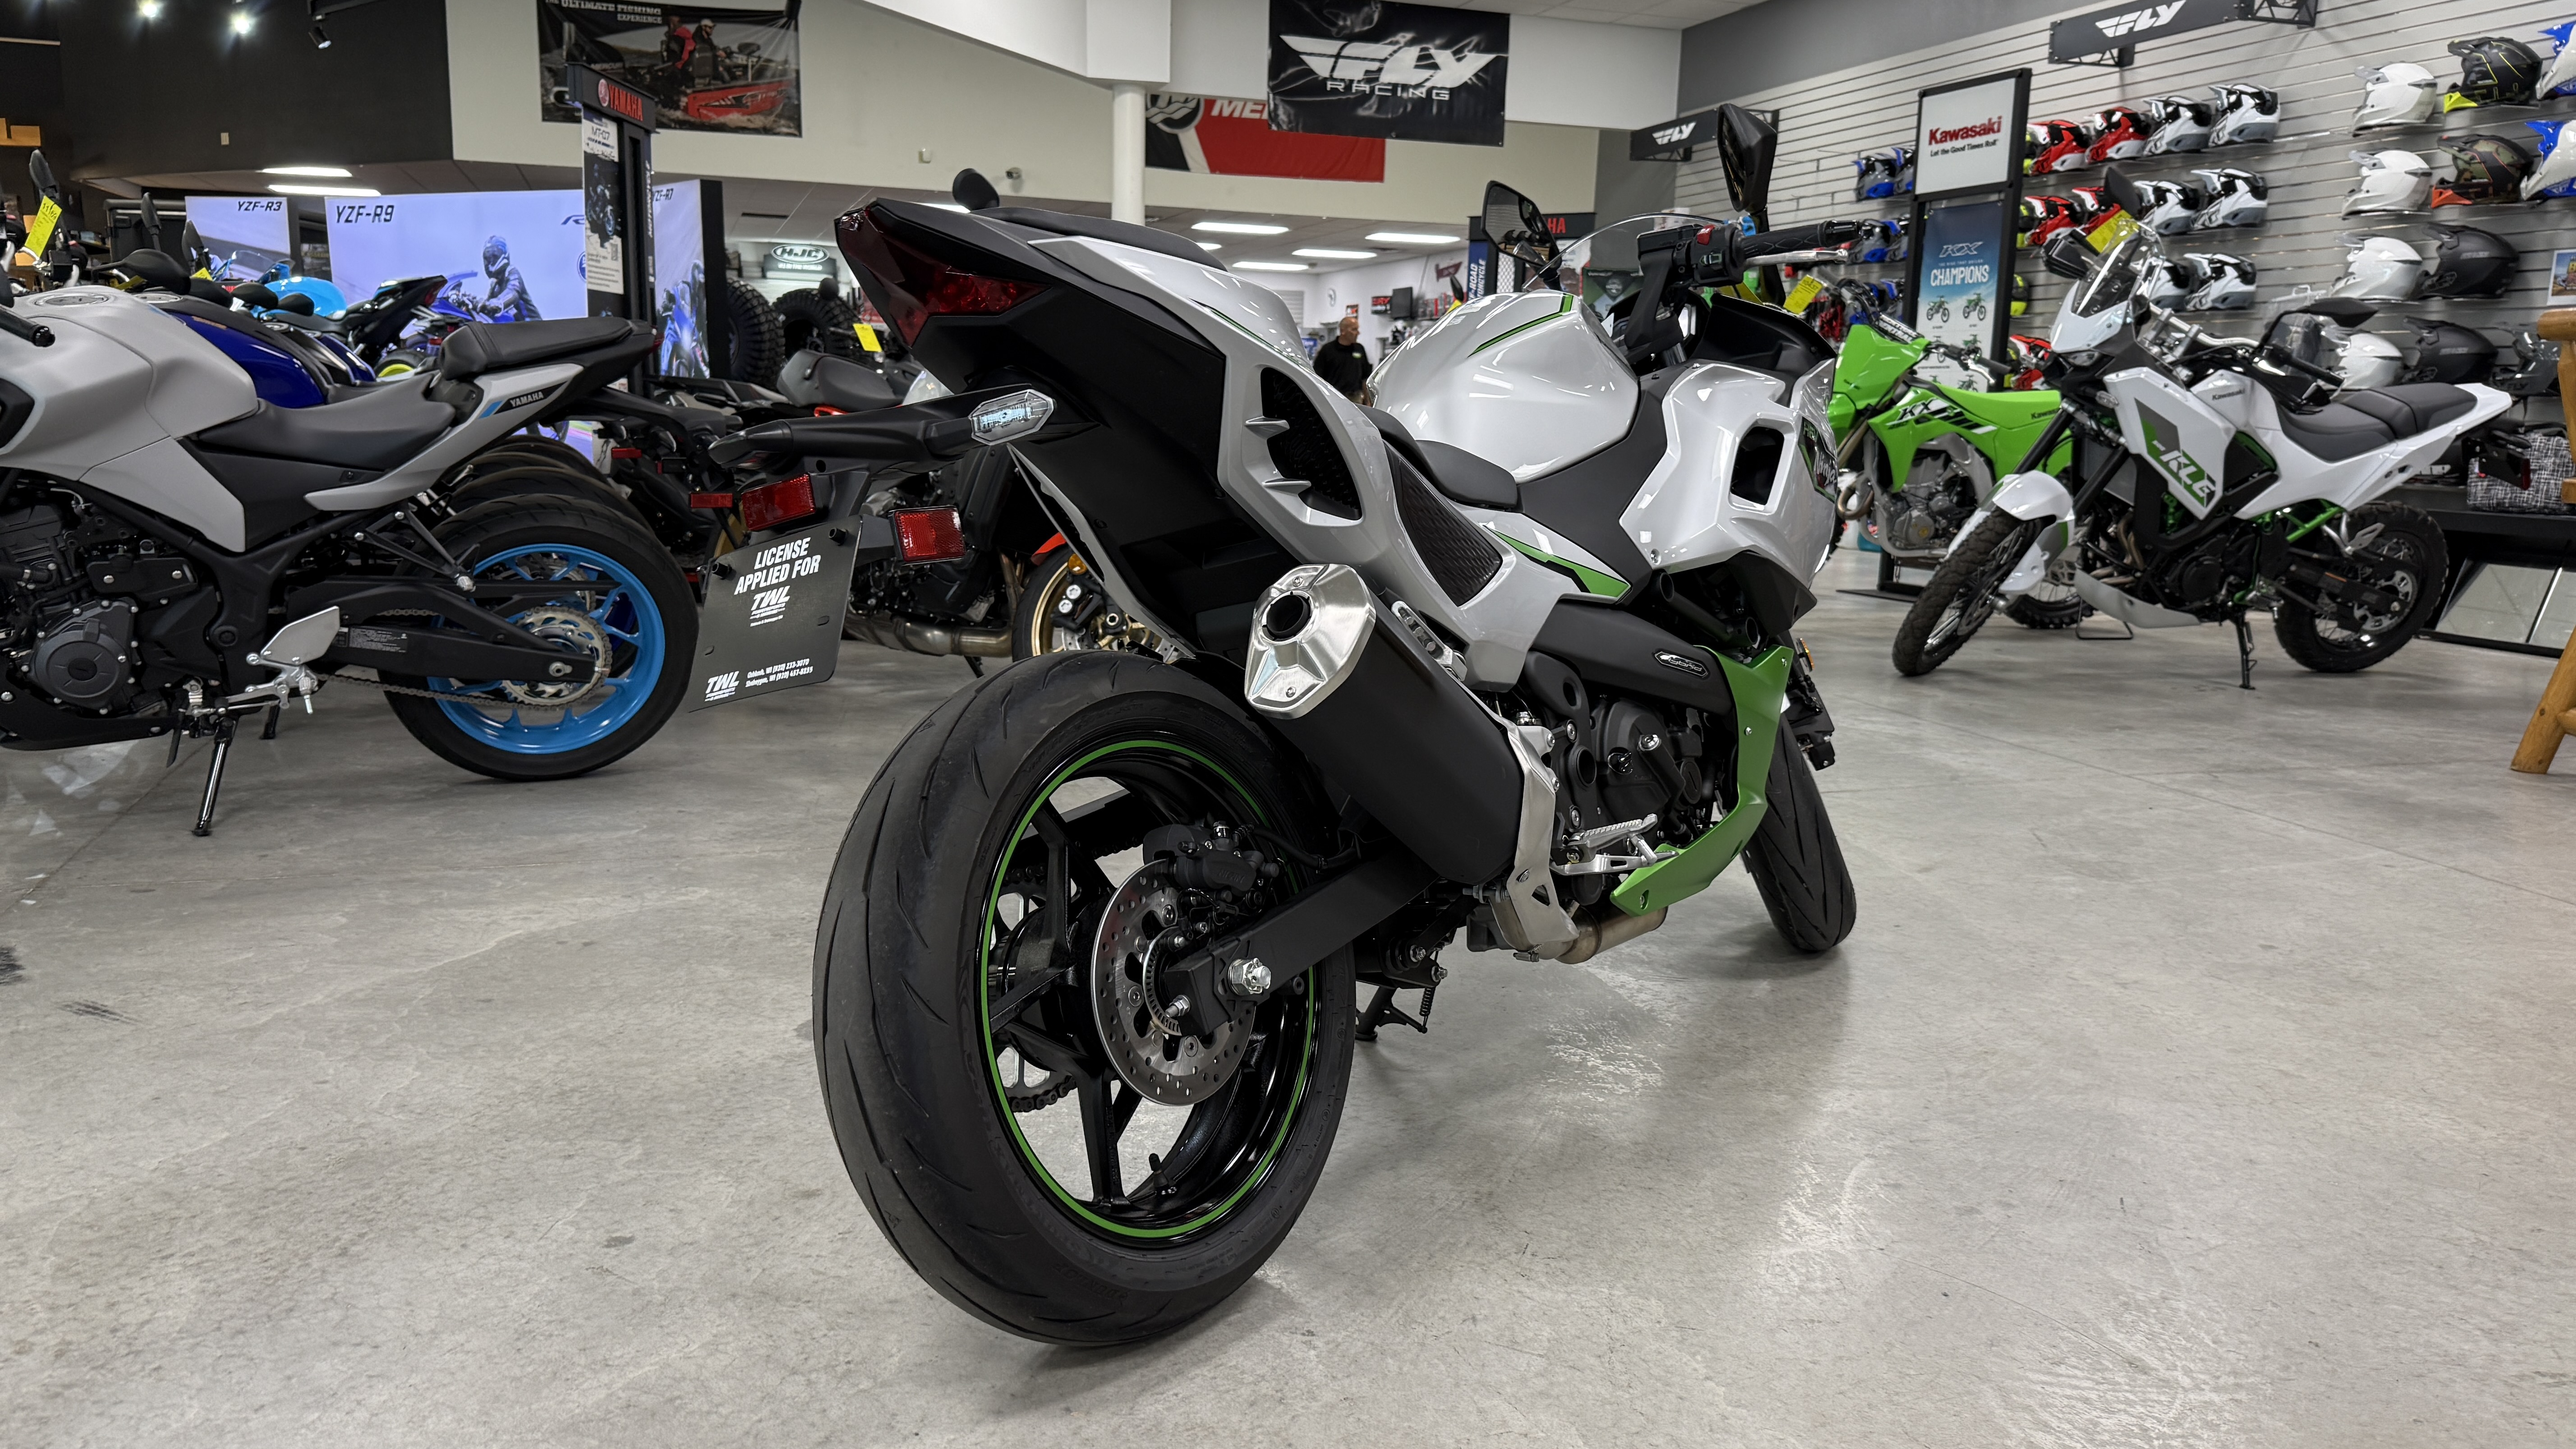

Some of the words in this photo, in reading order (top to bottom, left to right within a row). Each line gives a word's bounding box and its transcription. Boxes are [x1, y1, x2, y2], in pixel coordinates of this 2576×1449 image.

[2095, 0, 2186, 37] FLY
[1279, 34, 1497, 88] FLY
[1326, 80, 1450, 100] RACING
[609, 84, 644, 122] YAMAHA
[1652, 121, 1696, 145] FLY
[1928, 115, 2002, 146] Kawasaki
[1950, 144, 1966, 153] Good
[1967, 142, 1984, 150] Times
[237, 201, 283, 212] YZF-R3
[336, 204, 395, 224] YZF-R9
[781, 247, 821, 258] HJC
[1939, 241, 1984, 258] KX
[1930, 264, 1990, 286] CHAMPIONS
[510, 391, 544, 407] YAMAHA
[2212, 388, 2245, 400] Kawasaki
[1813, 451, 1837, 487] Ninja
[754, 537, 811, 570] LICENSE
[734, 563, 790, 595] APPLIED
[791, 555, 821, 579] FOR
[750, 585, 791, 611] TWL
[705, 671, 740, 694] TWL
